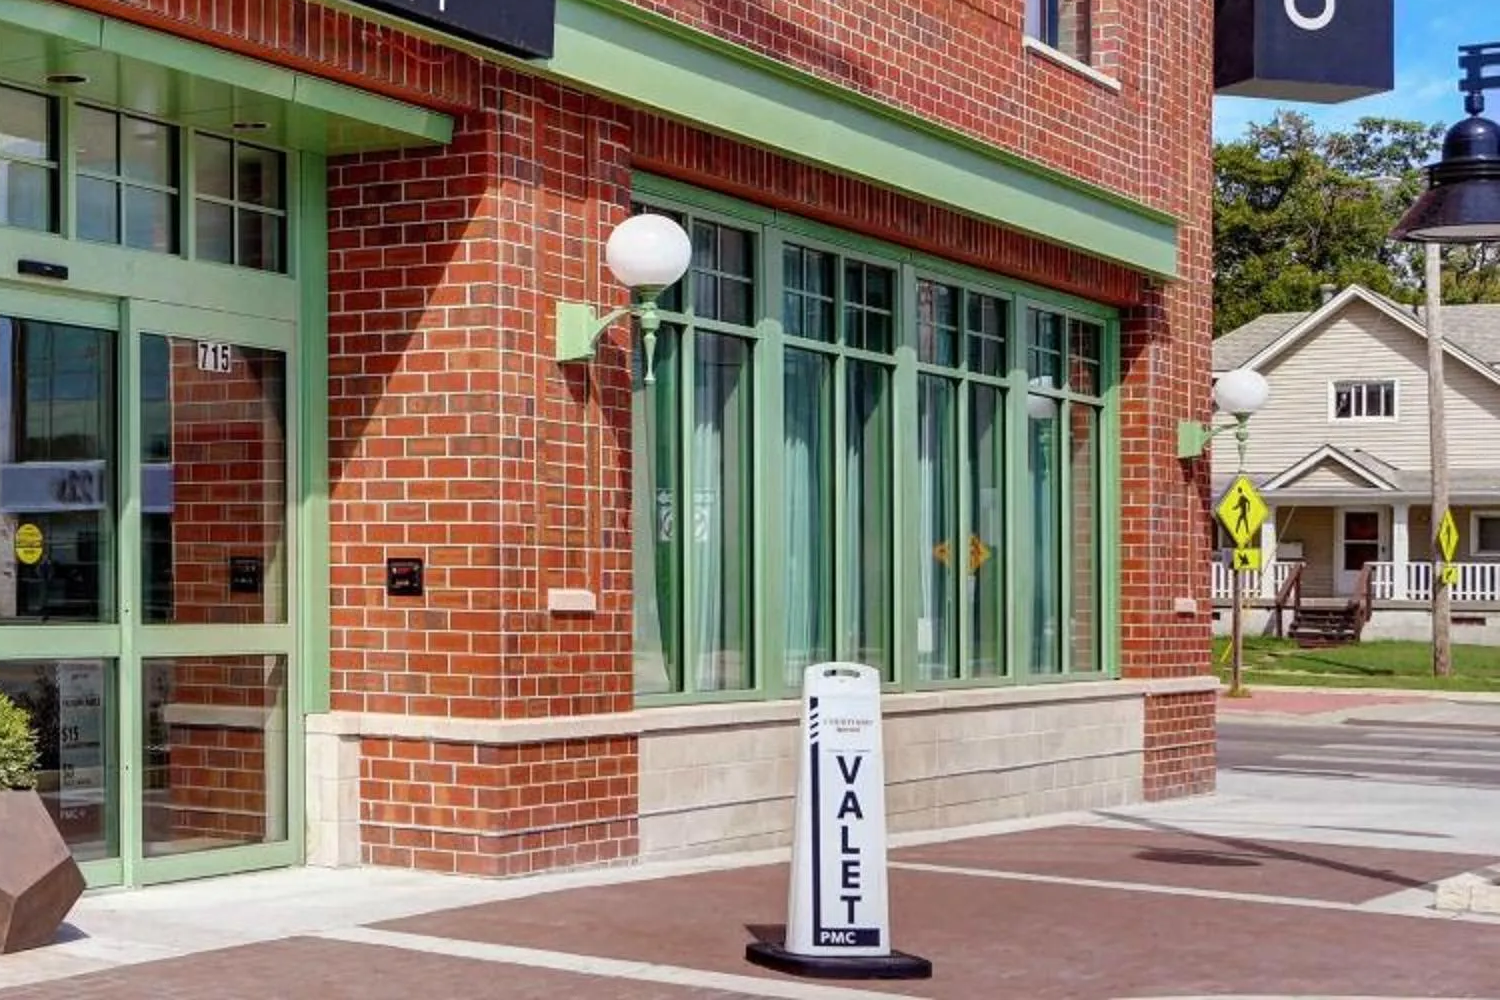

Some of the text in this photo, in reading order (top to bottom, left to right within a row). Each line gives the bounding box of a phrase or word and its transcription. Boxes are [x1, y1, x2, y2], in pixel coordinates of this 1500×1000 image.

[200, 343, 229, 370] 715
[835, 755, 864, 925] VALET
[820, 931, 856, 944] PMC
